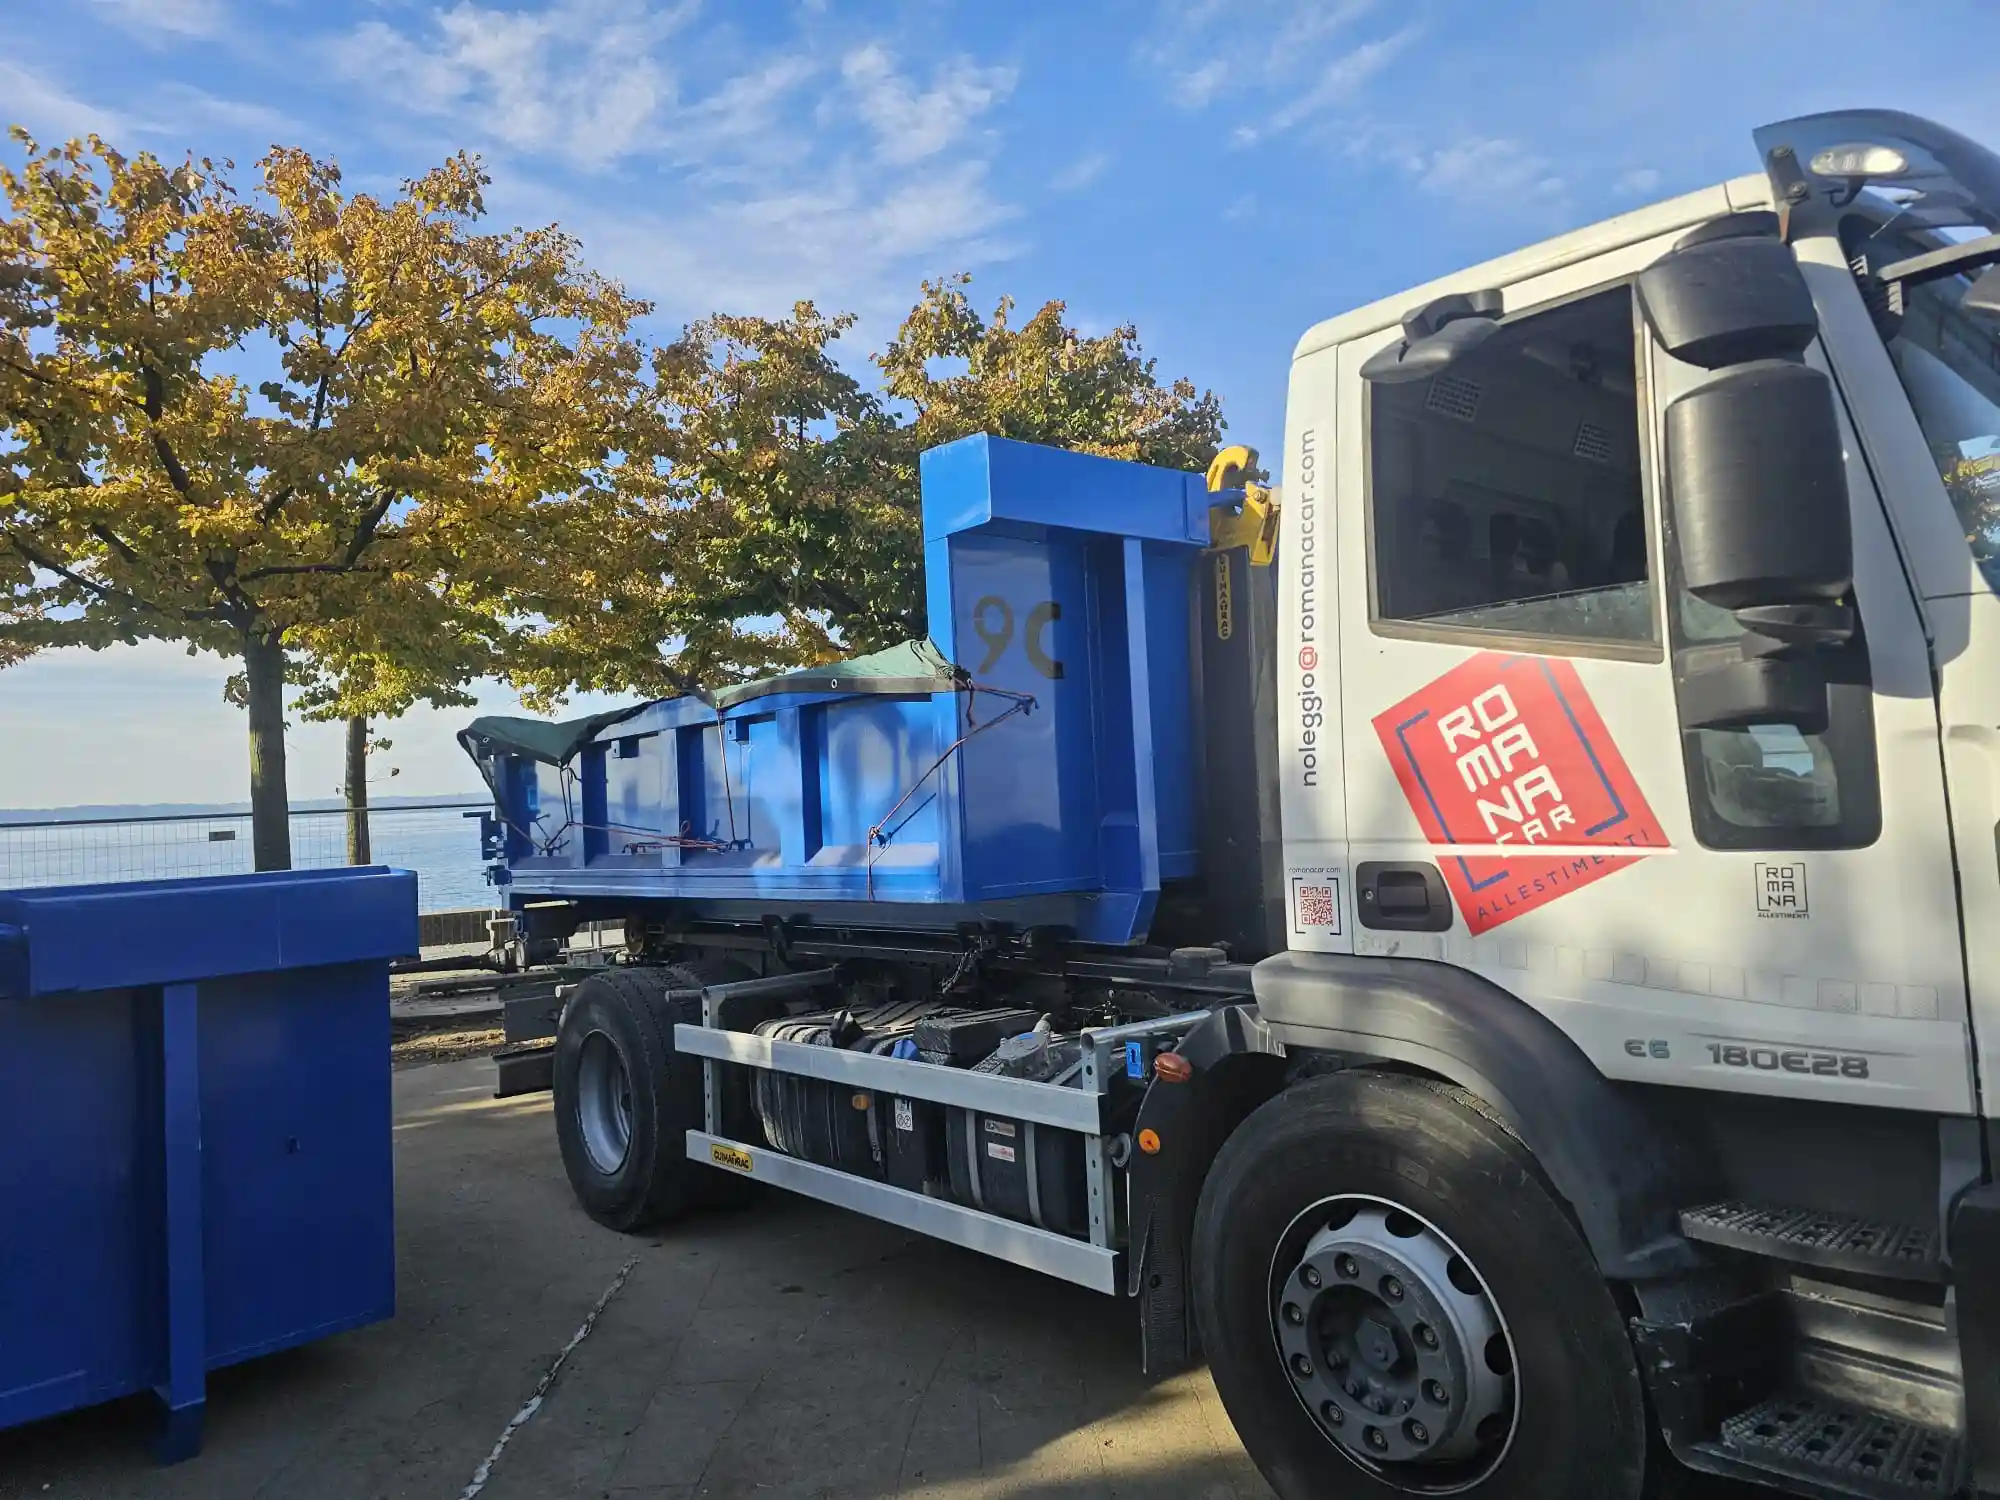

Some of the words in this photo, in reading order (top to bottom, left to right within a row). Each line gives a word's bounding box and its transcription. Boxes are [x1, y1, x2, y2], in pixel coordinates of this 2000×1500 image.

[1298, 428, 1322, 787] noleggio@romanacar.com
[1437, 684, 1519, 753] RO
[1456, 723, 1539, 792] MA
[1476, 764, 1562, 835] NA
[1477, 828, 1650, 921] ALLESTIMETI
[1766, 867, 1794, 878] RO
[1767, 881, 1795, 892] MA
[1768, 895, 1796, 906] NA
[1706, 1043, 1869, 1079] 180E28
